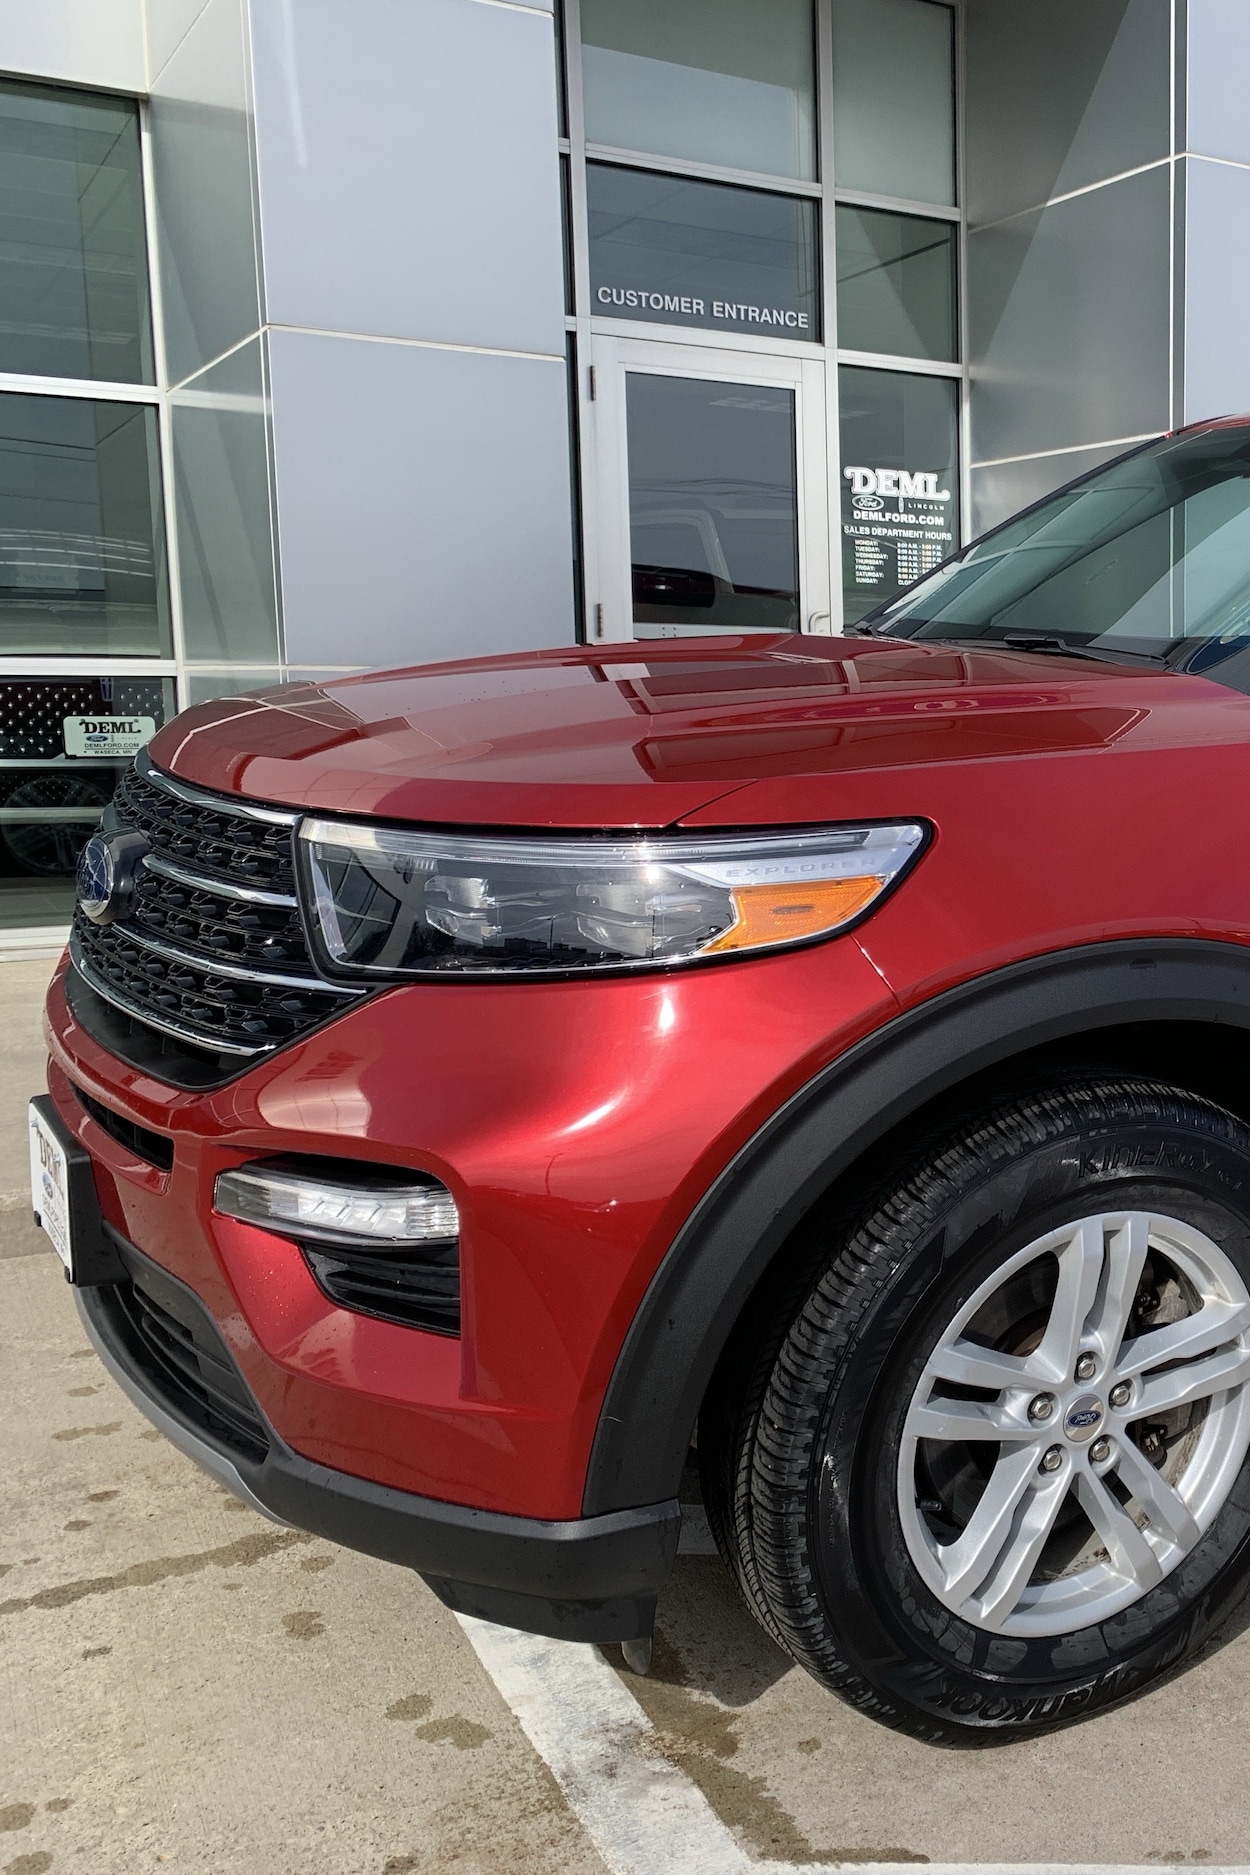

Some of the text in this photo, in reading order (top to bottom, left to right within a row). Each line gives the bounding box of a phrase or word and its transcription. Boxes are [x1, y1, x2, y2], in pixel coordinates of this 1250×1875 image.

[597, 286, 809, 329] CUSTOMER ENTRANCE
[843, 466, 951, 501] DEML
[908, 502, 945, 511] LINCOLN
[853, 510, 945, 526] DEMLFORD.COM
[843, 526, 952, 540] SALES DEPARTMENT HOURS
[79, 721, 141, 734] DEML
[725, 858, 875, 878] EXPLORER
